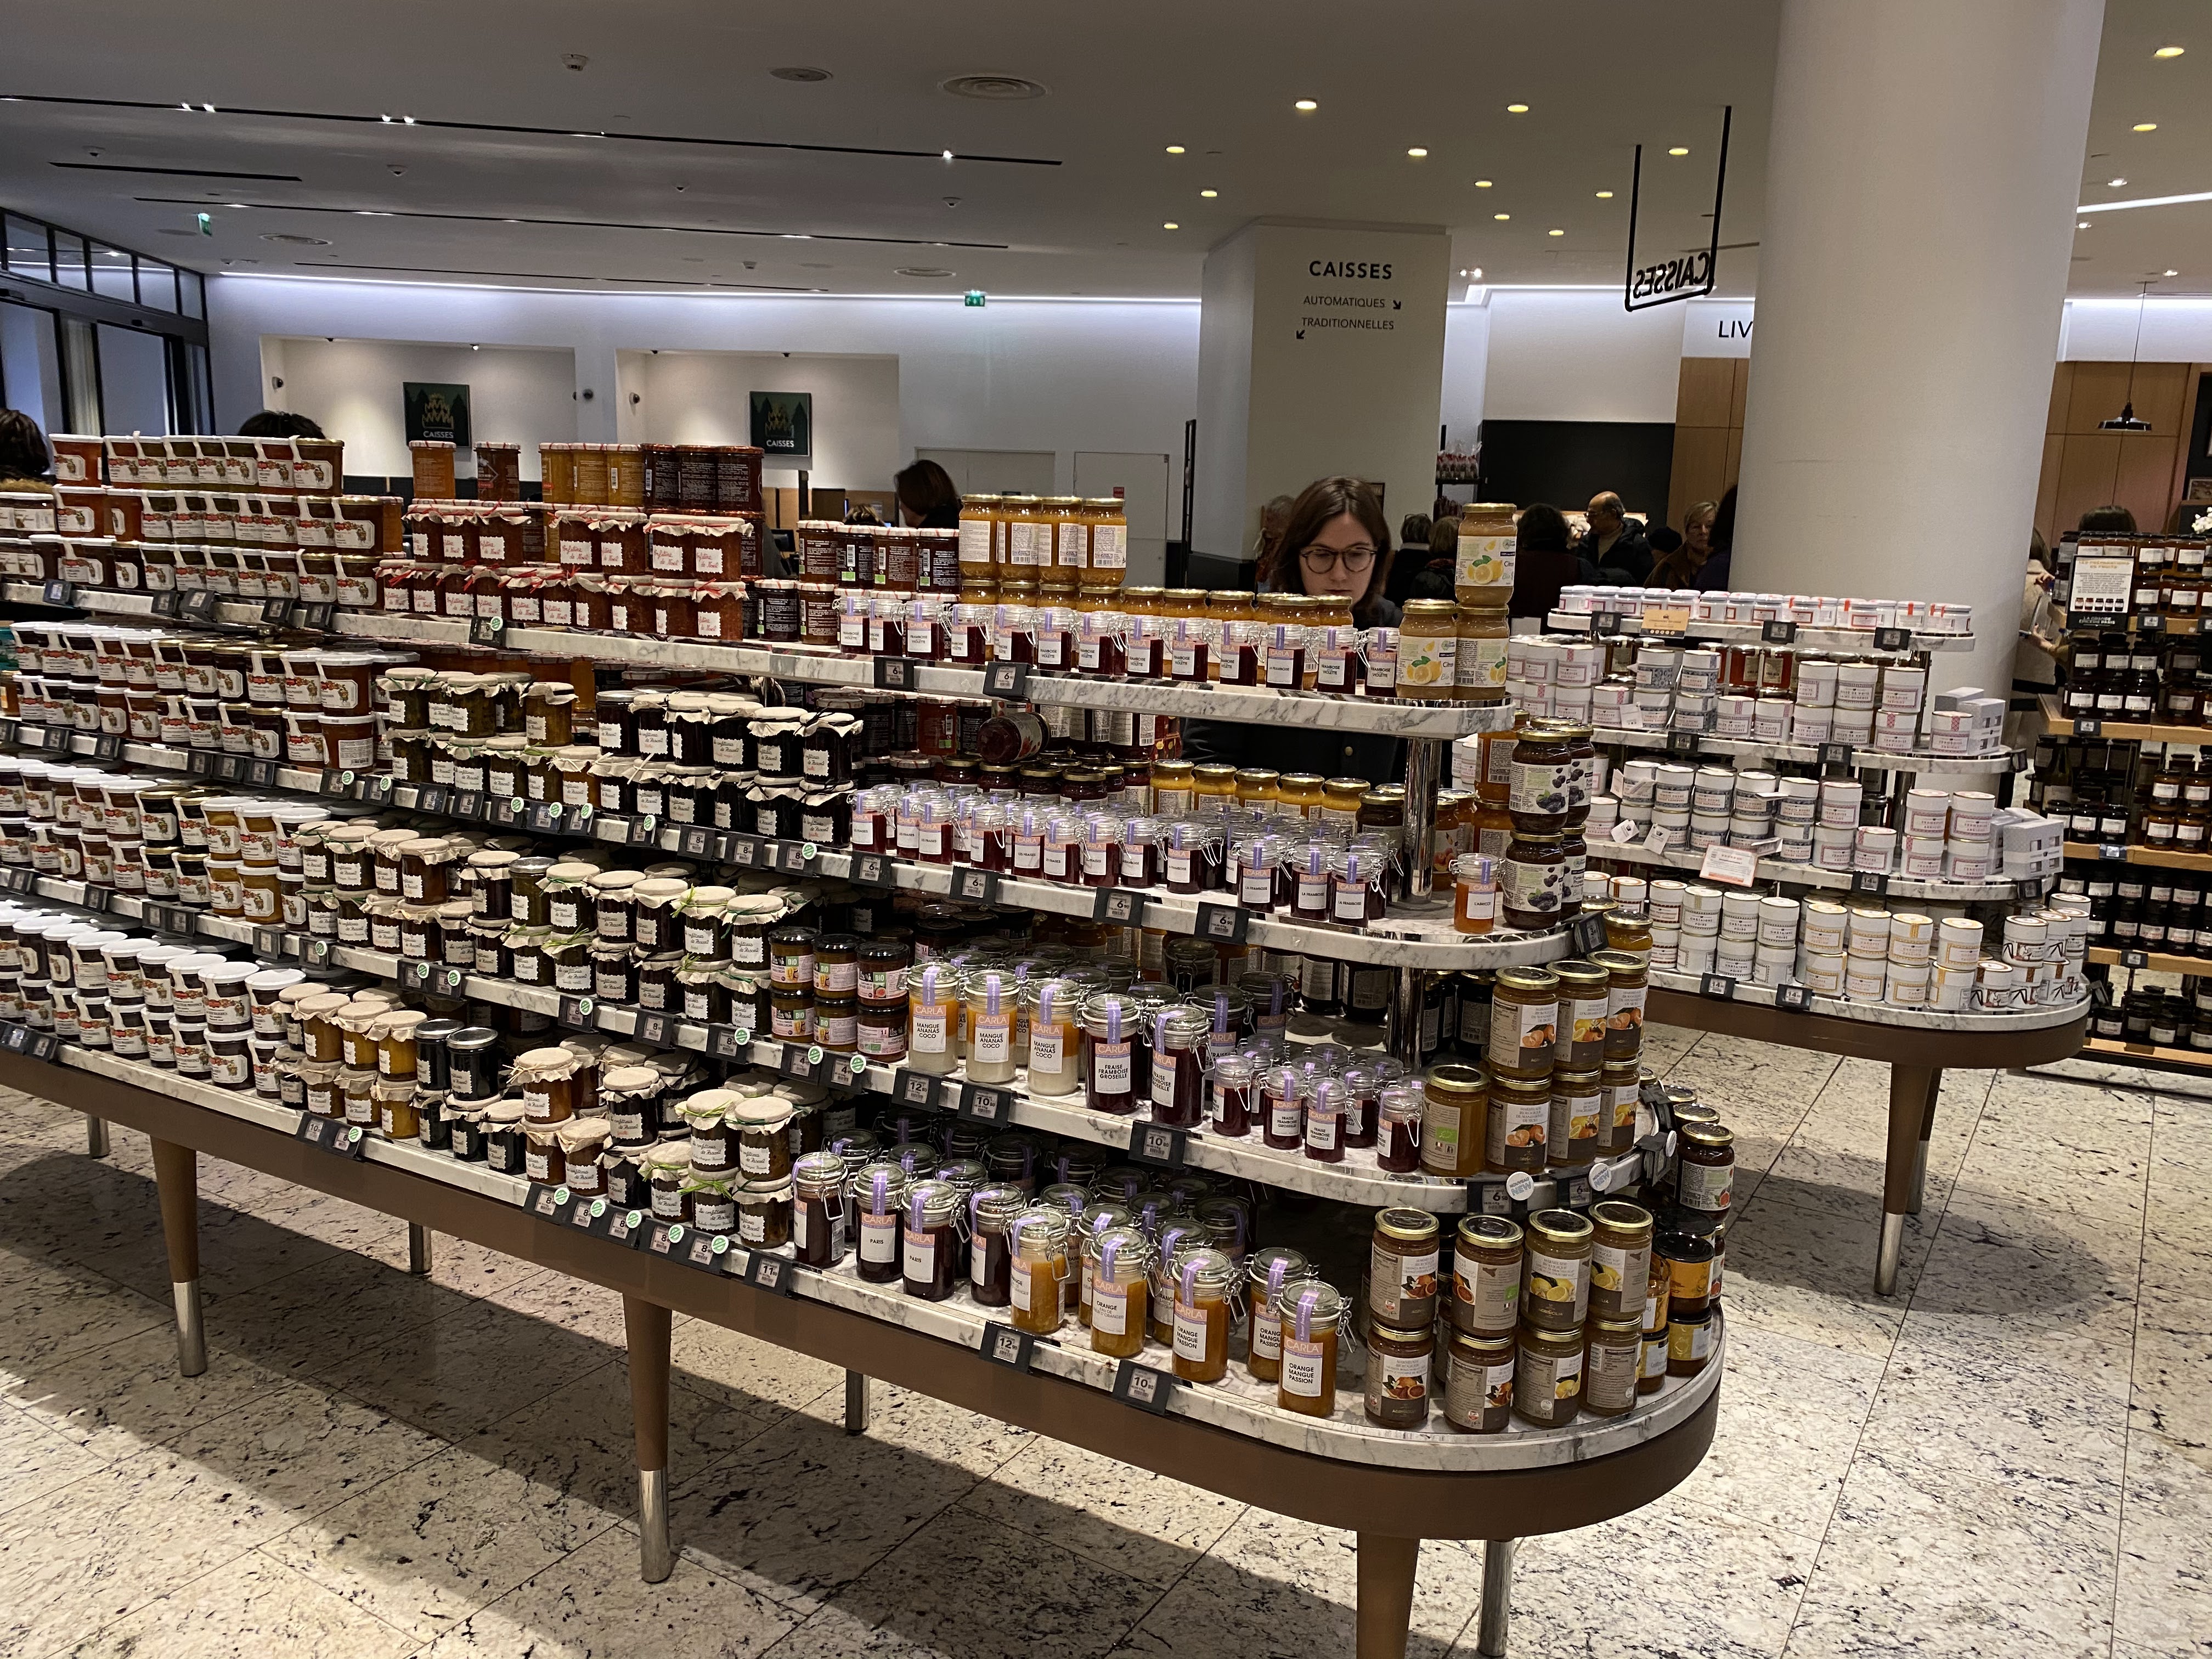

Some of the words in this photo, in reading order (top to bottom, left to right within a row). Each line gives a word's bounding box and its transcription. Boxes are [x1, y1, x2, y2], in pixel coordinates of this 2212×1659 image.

[1309, 260, 1392, 280] CAISSES
[1303, 295, 1386, 308] AUTOMATIQUES
[1301, 317, 1395, 330] TRADITIONNELLES
[423, 431, 454, 439] CAISSES
[766, 439, 794, 448] CAISSES
[915, 1006, 944, 1015] CARLA
[978, 1015, 1007, 1024] CARLA
[1033, 1024, 1060, 1034] CARLA
[1211, 1033, 1234, 1042] ARLA
[1098, 1045, 1128, 1054] CARLA
[1154, 1053, 1172, 1066] ARLA
[1594, 1170, 1610, 1188] NEW
[1511, 1181, 1531, 1197] NEW
[864, 1215, 893, 1225] CARLA
[905, 1231, 930, 1244] CARLA
[1094, 1280, 1124, 1294] CARLA
[1097, 1300, 1117, 1311] ORANGE
[1175, 1302, 1203, 1320] CARLA
[1177, 1325, 1198, 1338] ORANGE
[1260, 1328, 1280, 1336] ORANG
[1177, 1331, 1198, 1344] MANGUE
[1177, 1337, 1197, 1349] PASSION
[1260, 1333, 1280, 1342] MANGU
[1286, 1339, 1319, 1353] CARLA
[1289, 1363, 1314, 1372] ORANGE
[1289, 1368, 1314, 1378] MANGUE
[1289, 1374, 1313, 1384] PASSION
